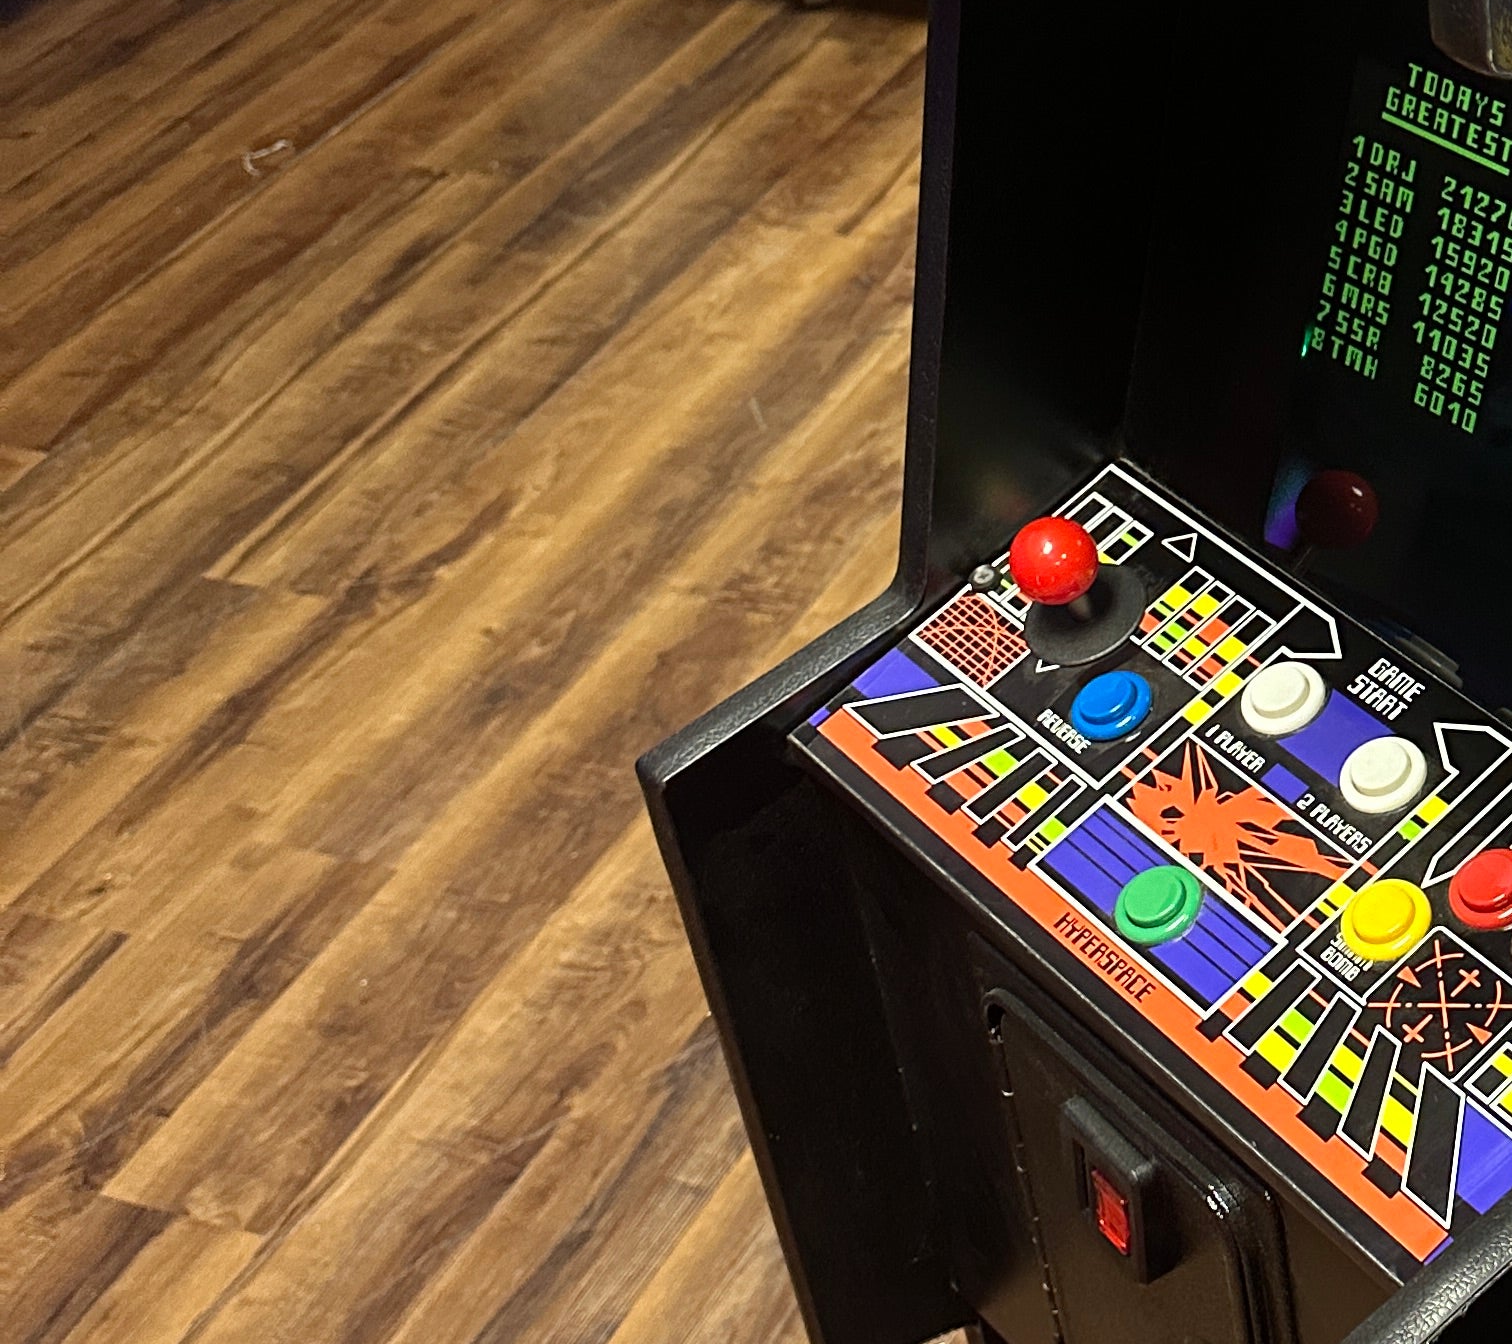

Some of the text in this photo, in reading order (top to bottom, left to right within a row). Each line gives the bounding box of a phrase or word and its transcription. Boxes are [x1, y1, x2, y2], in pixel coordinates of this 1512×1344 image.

[1408, 62, 1506, 127] TODAYS
[1370, 142, 1416, 183] DRJ
[1364, 170, 1414, 213] SAM
[1358, 199, 1403, 238] LED
[1431, 235, 1510, 292] 15920
[1419, 292, 1497, 350] 12520
[1425, 264, 1503, 321] 14285
[1335, 309, 1380, 351] SSR
[1420, 355, 1484, 406] 8265
[1341, 282, 1390, 326] MRS
[1412, 320, 1490, 378] 11035
[1331, 336, 1378, 380] TMH
[1414, 382, 1477, 434] 6010
[1347, 674, 1409, 721] START
[1367, 657, 1427, 704] GAME
[1036, 708, 1092, 755] REVERSE
[1204, 722, 1267, 774] 1 PLAYER
[1296, 792, 1373, 854] 2 PLAYERS
[1053, 912, 1157, 1003] HYPERSPACE
[1320, 945, 1360, 982] BOMB
